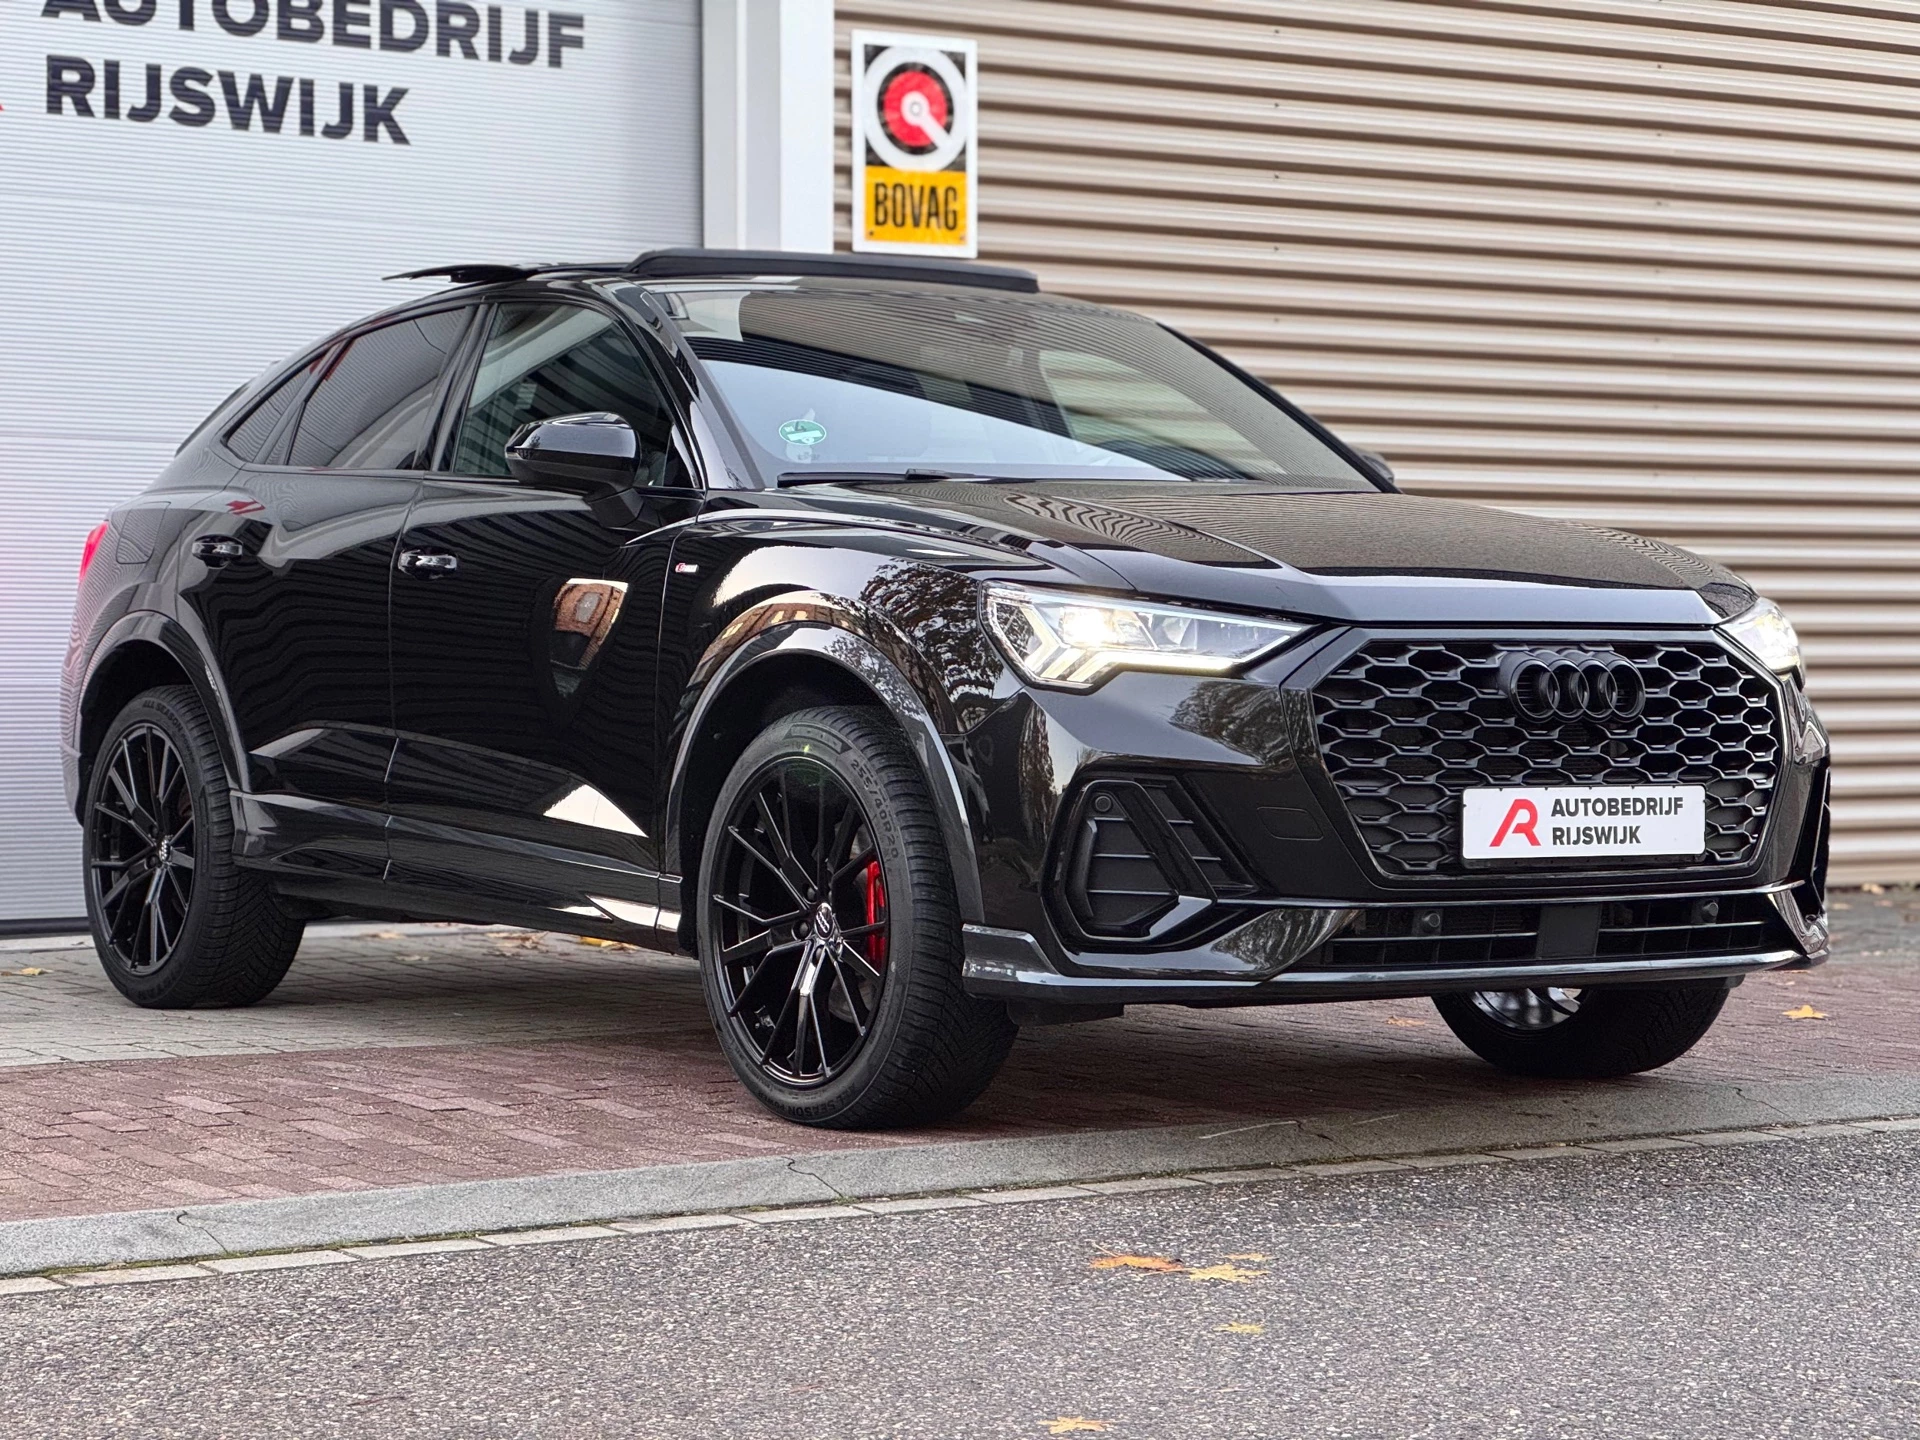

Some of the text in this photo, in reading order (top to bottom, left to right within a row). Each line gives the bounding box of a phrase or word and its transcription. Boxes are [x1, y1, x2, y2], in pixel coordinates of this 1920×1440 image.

[46, 54, 411, 146] RIJSWIJK
[875, 182, 957, 231] BOVAG
[850, 758, 899, 859] 255/40R20
[1551, 797, 1684, 817] AUTOBEDRIJF
[1552, 826, 1642, 846] RIJSWIJK
